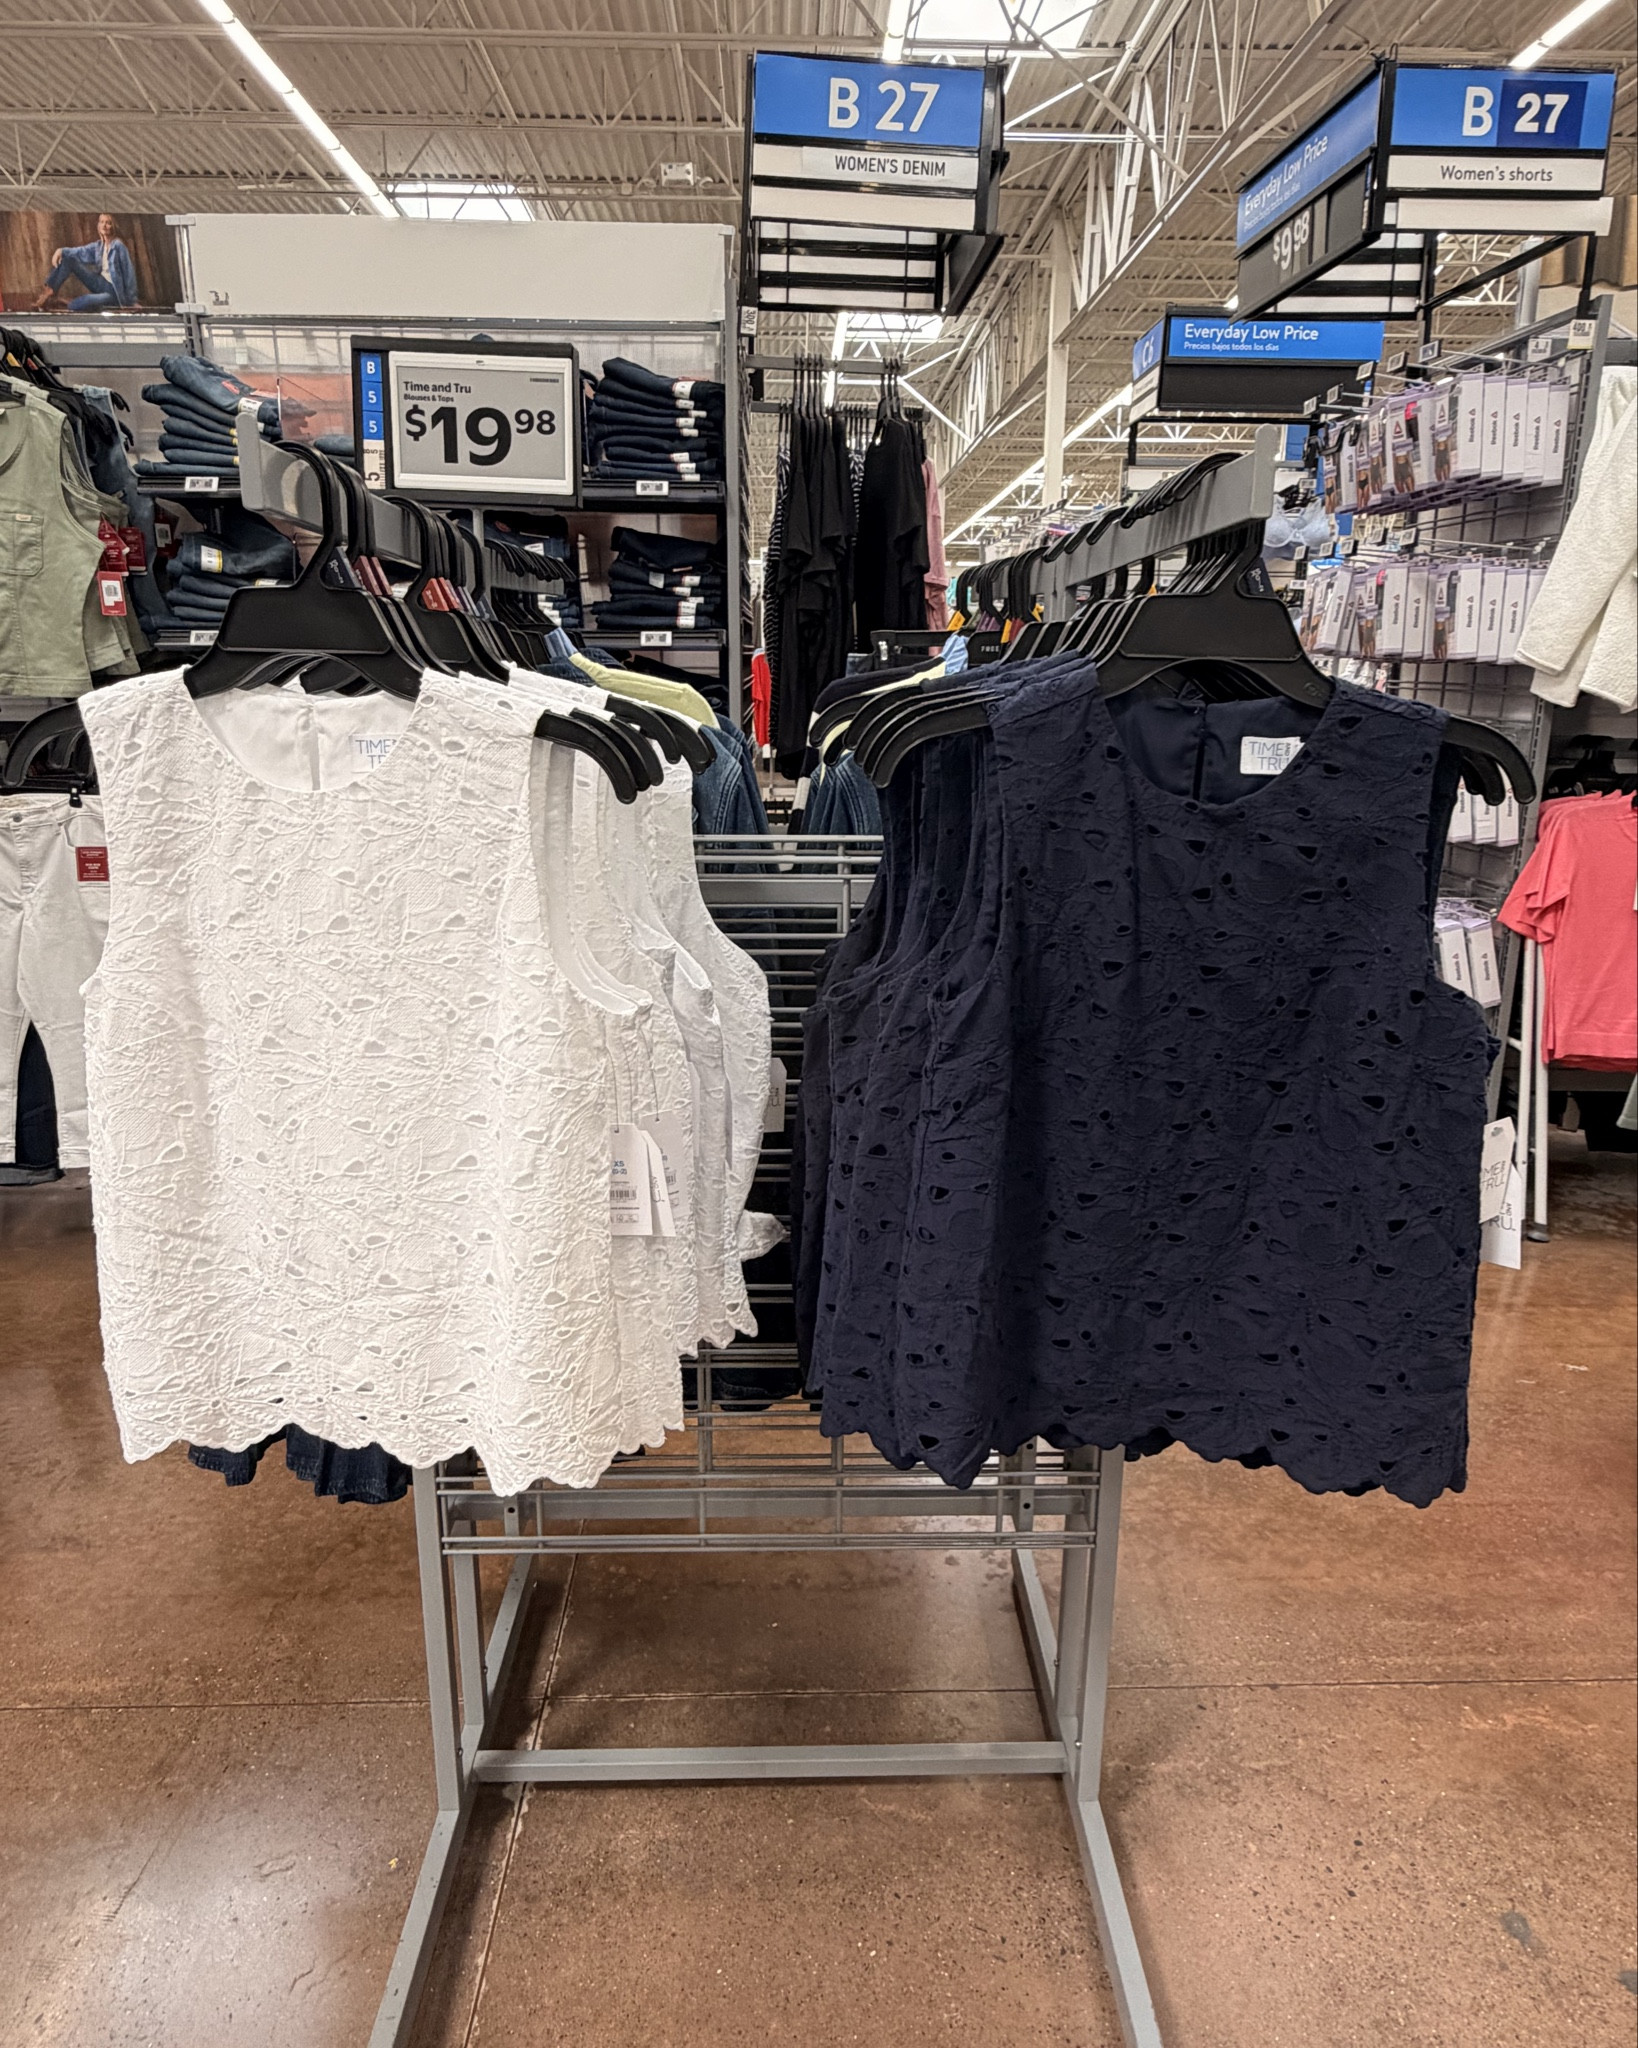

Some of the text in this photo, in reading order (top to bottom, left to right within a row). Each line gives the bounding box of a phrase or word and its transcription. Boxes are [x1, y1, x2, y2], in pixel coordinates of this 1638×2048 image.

[828, 77, 940, 132] B 27
[1462, 86, 1569, 136] B 27
[835, 155, 946, 177] WOMEN'S DENIM
[1441, 164, 1553, 181] Women's shorts
[1244, 172, 1282, 217] Everyday
[1283, 156, 1303, 184] Low
[1304, 135, 1328, 168] Price
[1184, 323, 1319, 343] Everyday Low Price
[367, 361, 375, 374] B
[403, 381, 472, 394] Time and Tru
[368, 391, 377, 403] 5
[403, 393, 431, 401] Blouses
[437, 395, 454, 403] Tops
[369, 420, 378, 433] 5
[355, 738, 391, 755] TIME
[1248, 741, 1284, 757] TIME
